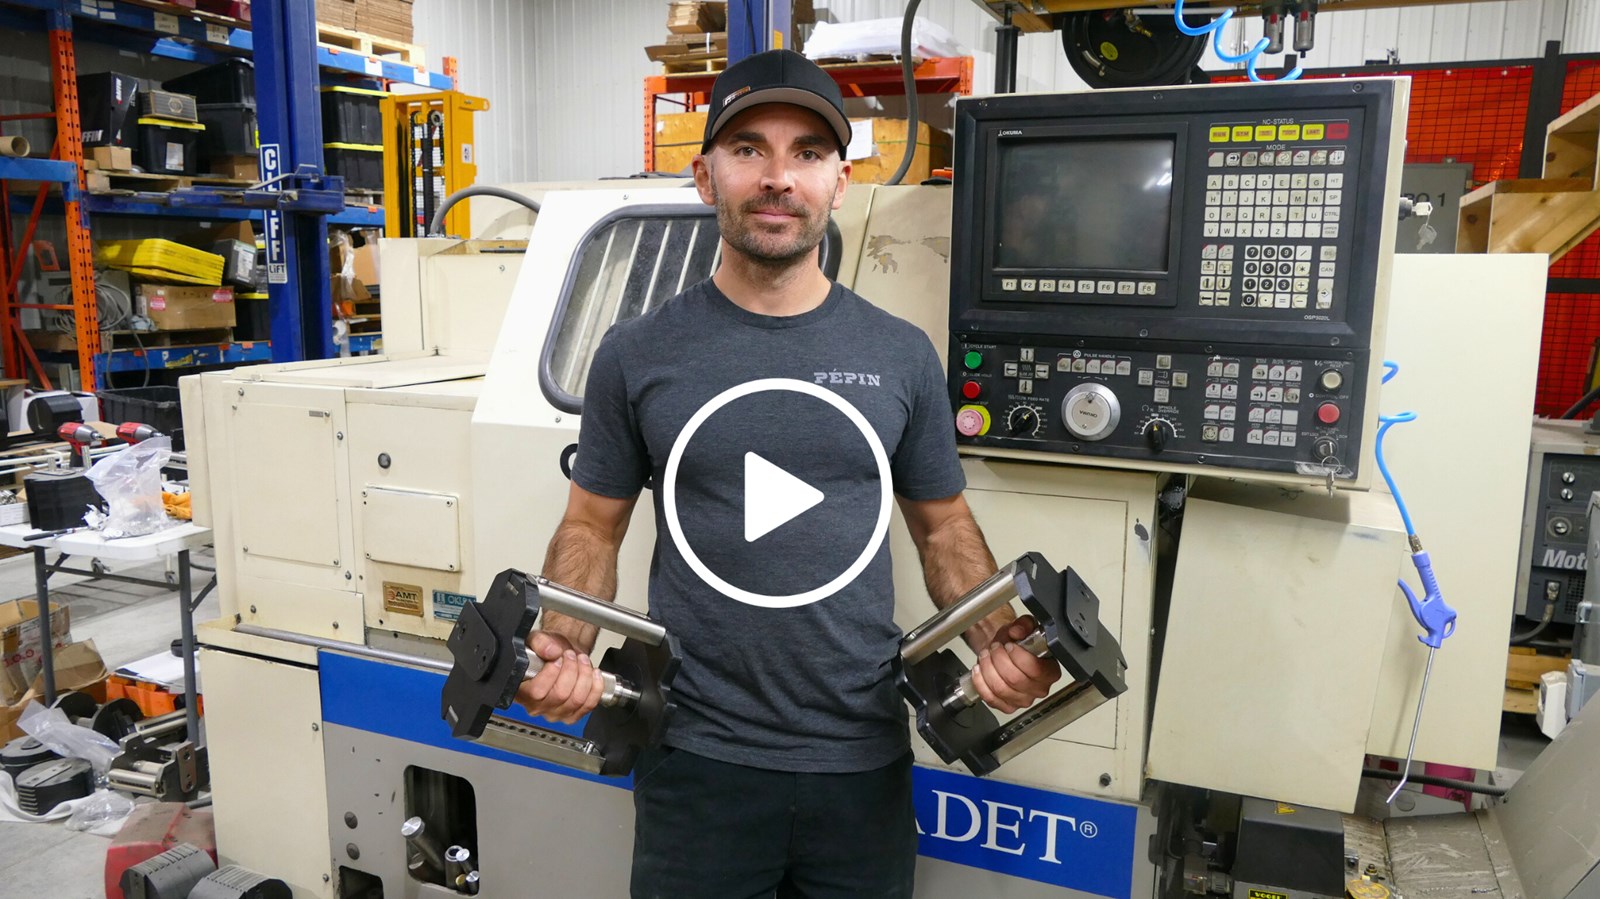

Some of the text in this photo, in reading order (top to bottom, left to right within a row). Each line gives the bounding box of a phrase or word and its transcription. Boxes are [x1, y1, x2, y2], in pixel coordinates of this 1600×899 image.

[264, 148, 281, 261] CLFF
[814, 368, 881, 387] PÉPIN
[395, 591, 418, 599] AMT
